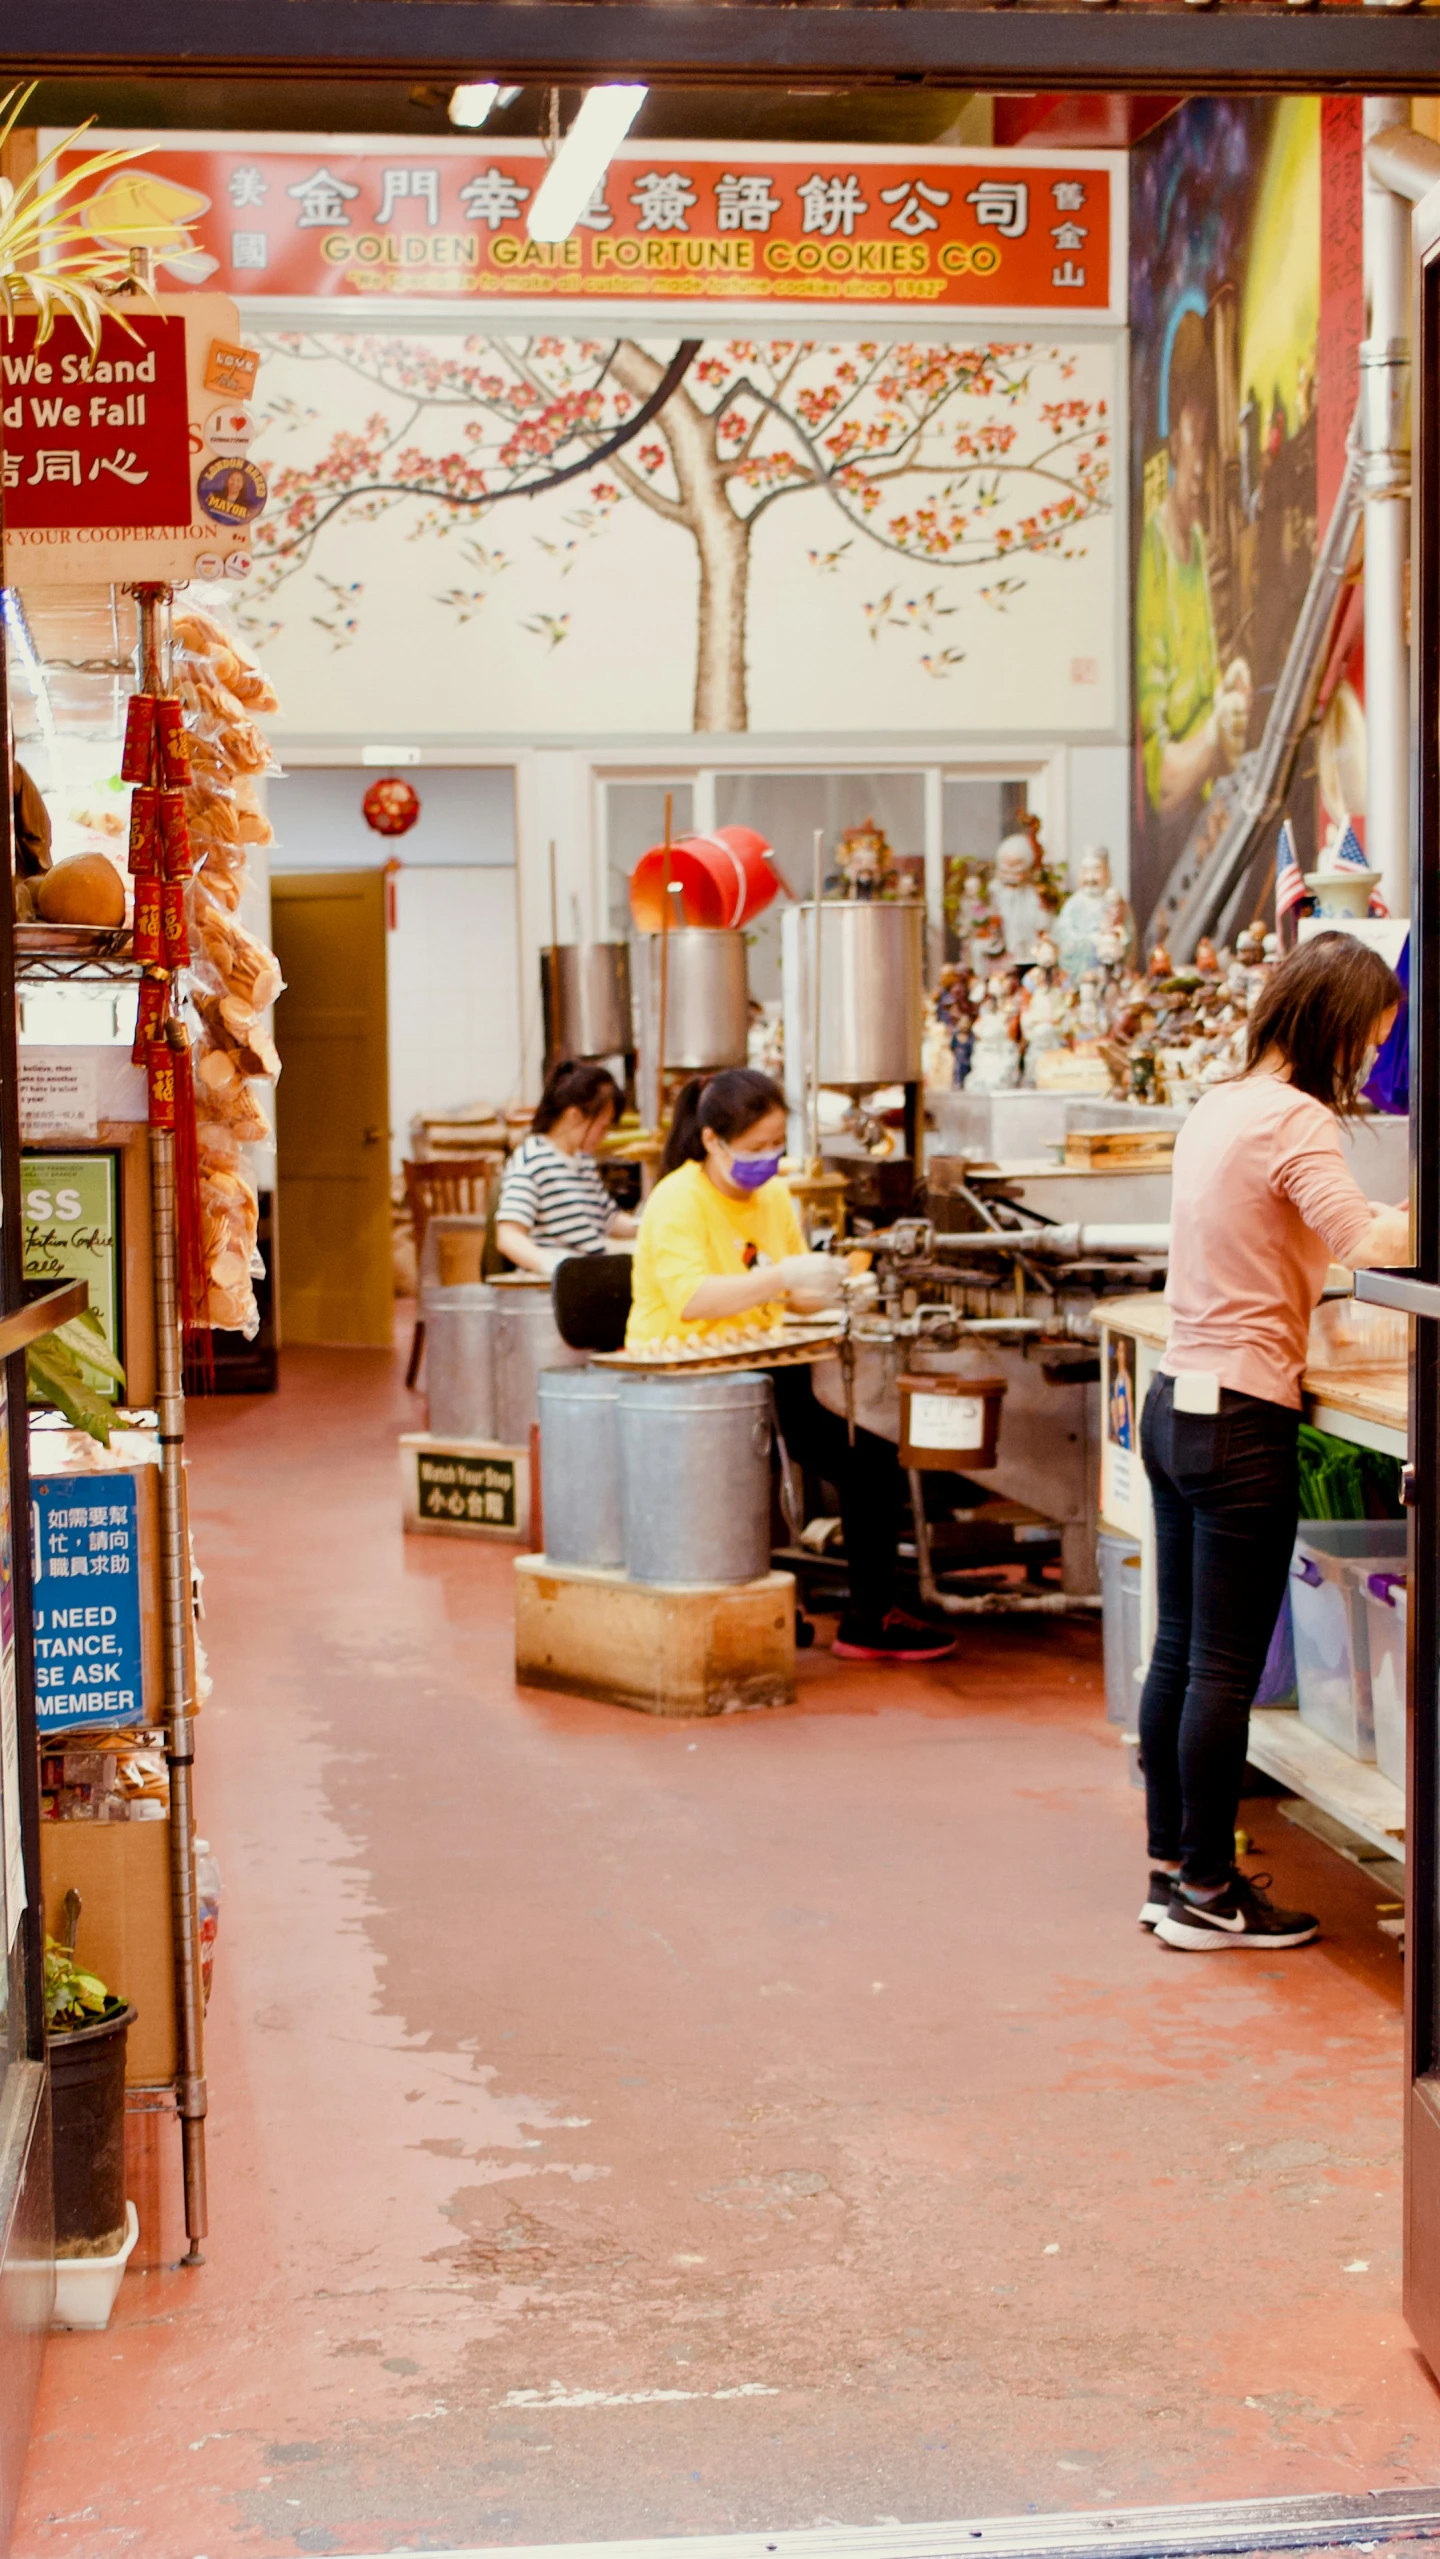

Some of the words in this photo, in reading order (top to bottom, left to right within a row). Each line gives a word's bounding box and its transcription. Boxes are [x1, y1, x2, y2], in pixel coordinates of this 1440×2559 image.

[228, 166, 269, 269] 美國
[1050, 181, 1088, 288] 舊金山
[322, 234, 476, 265] GOLDEN
[491, 235, 580, 267] GATE
[594, 238, 751, 269] FORTUNE
[766, 242, 927, 271] COOKIES
[940, 243, 998, 273] CO
[3, 355, 53, 386] We
[61, 350, 156, 384] Stand
[30, 396, 82, 428] We
[89, 394, 146, 428] Fall
[207, 495, 247, 519] MAYOR
[19, 528, 71, 545] YOUR
[77, 523, 217, 544] COOPERATION
[422, 1462, 456, 1484] Watch
[457, 1464, 484, 1487] Your
[485, 1466, 511, 1493] Step
[48, 1505, 128, 1530] 如需要幫
[48, 1530, 129, 1554] 忙，請向
[49, 1554, 130, 1579] 職員求助
[52, 1606, 117, 1629] NEED
[72, 1662, 121, 1685] ASK
[36, 1690, 134, 1716] MEMBER
